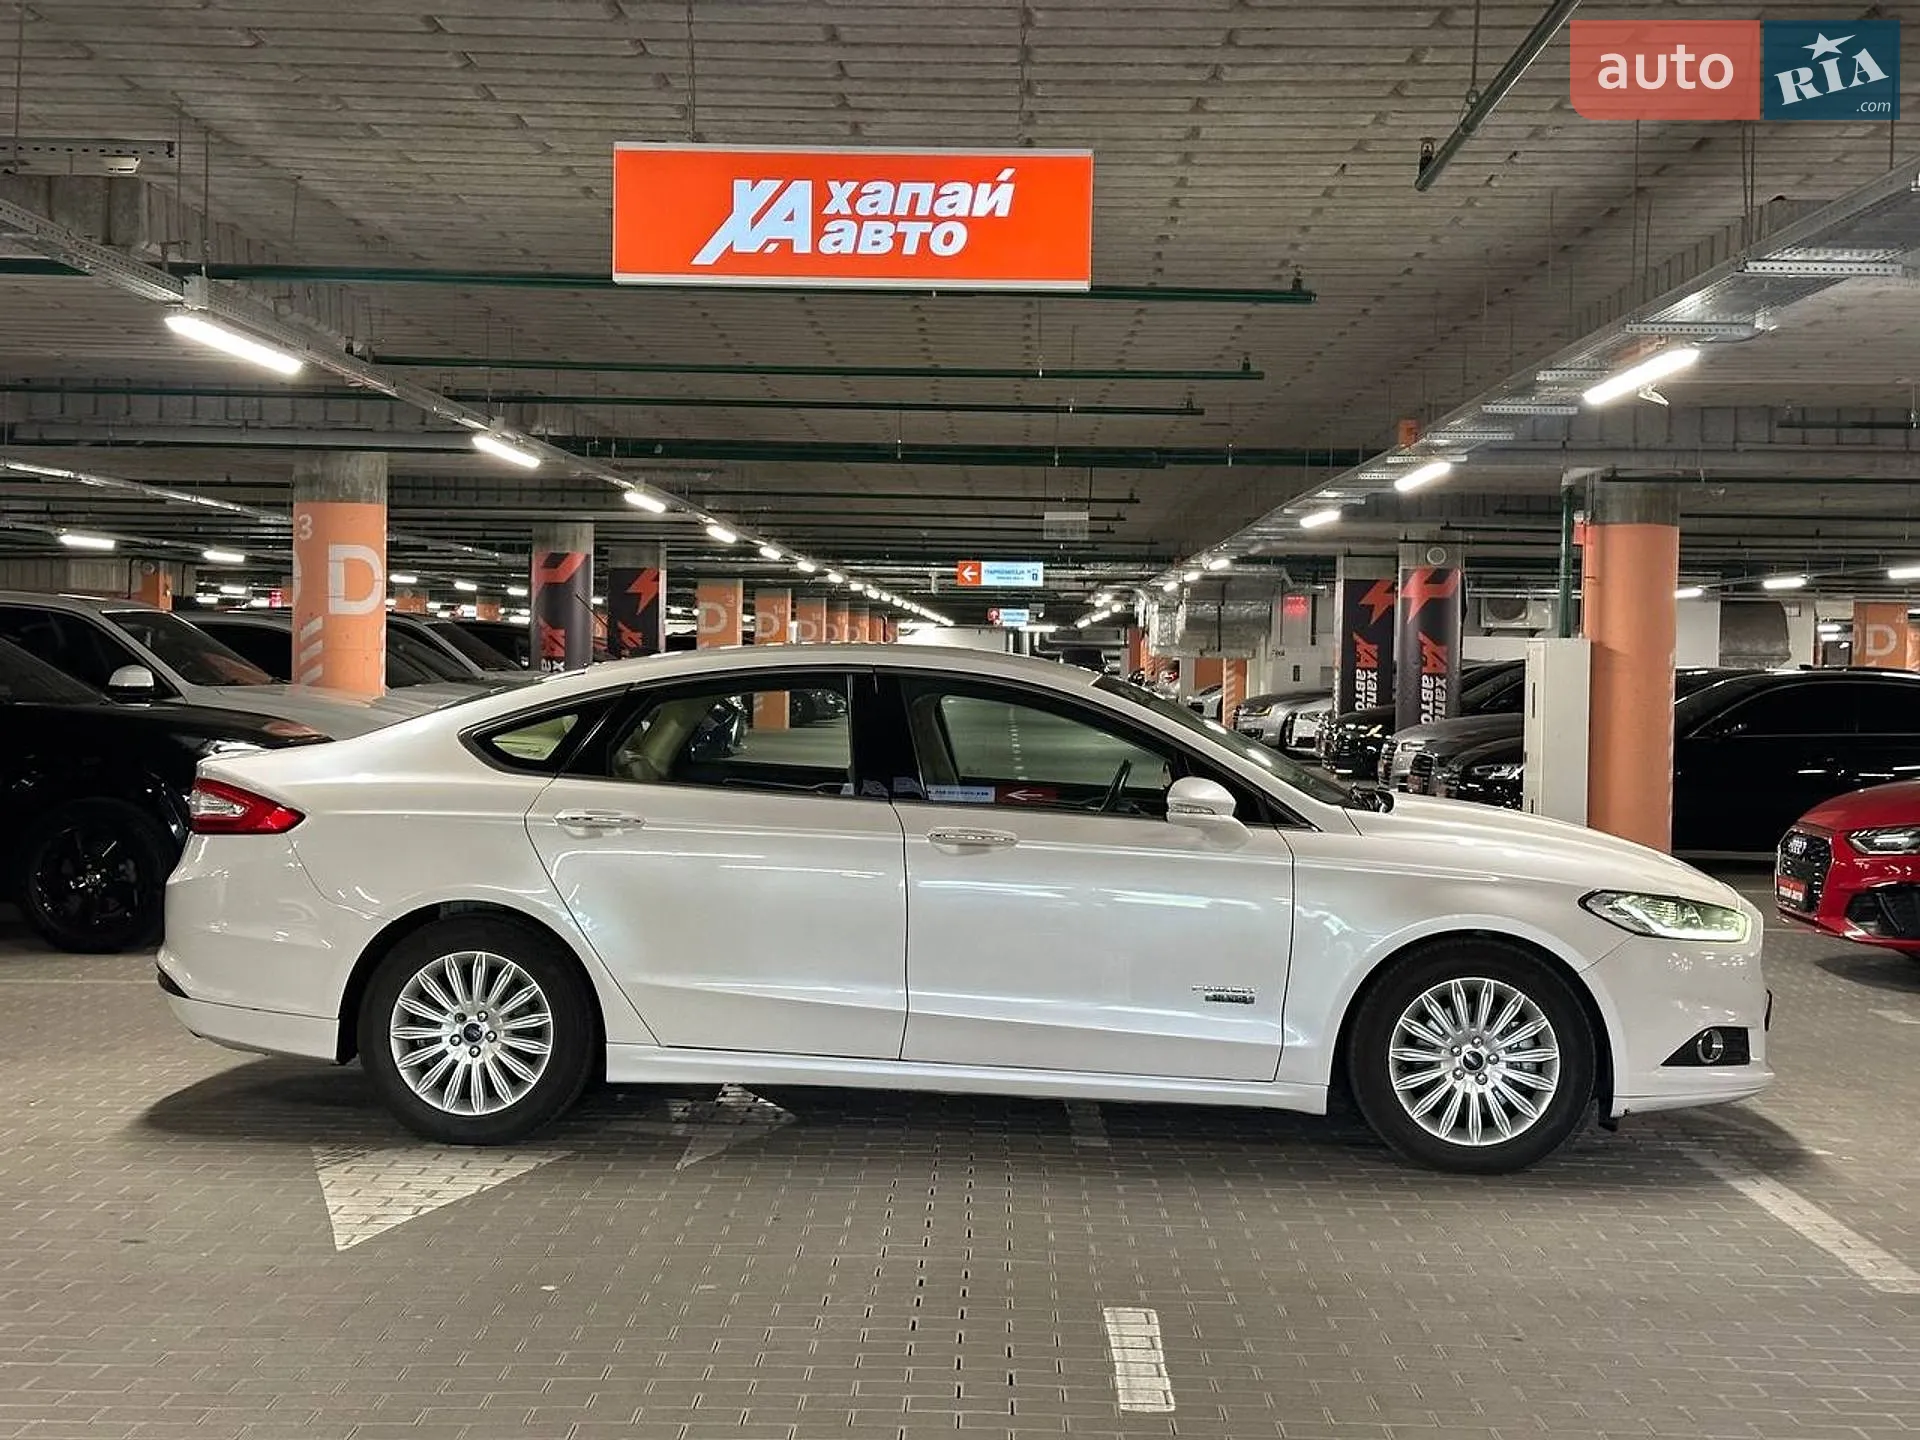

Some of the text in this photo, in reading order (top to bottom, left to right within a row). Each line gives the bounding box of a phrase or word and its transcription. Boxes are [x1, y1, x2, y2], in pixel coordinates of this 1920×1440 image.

[817, 218, 968, 258] авто
[328, 544, 384, 615] D
[698, 602, 729, 635] D
[755, 611, 781, 639] D
[1866, 623, 1897, 657] D
